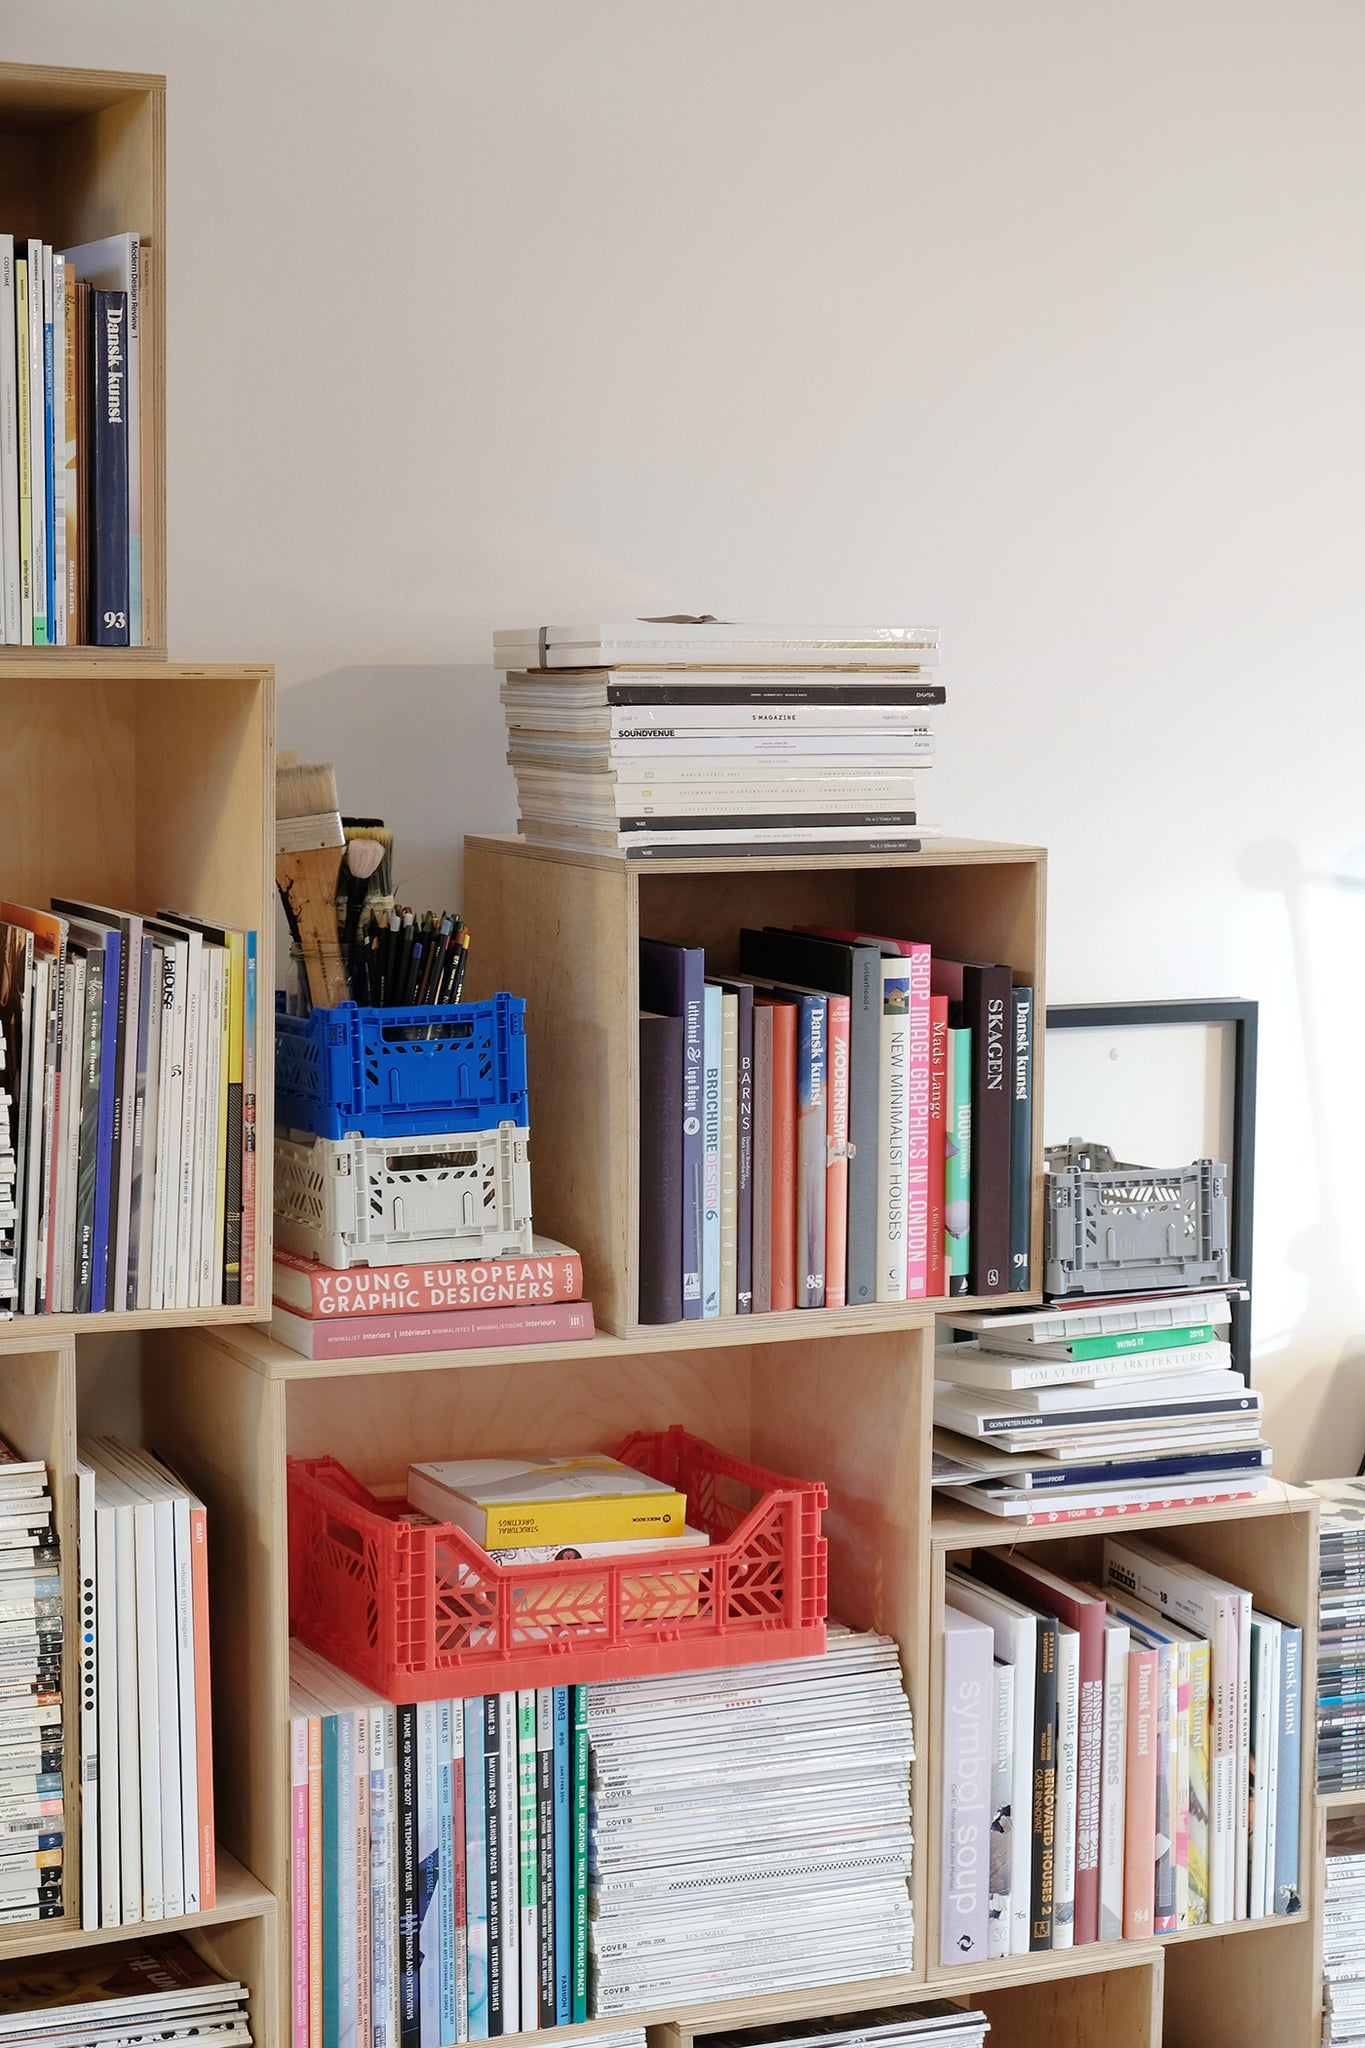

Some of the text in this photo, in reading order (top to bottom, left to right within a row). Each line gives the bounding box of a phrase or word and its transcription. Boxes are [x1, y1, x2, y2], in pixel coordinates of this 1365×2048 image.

[2, 256, 10, 288] COSTUME
[130, 273, 138, 301] Design
[106, 308, 124, 424] Dansk kunst
[103, 611, 126, 629] 93
[758, 714, 796, 722] MAGAZINE
[618, 729, 676, 737] SOUNDVENUE
[77, 965, 85, 992] VOGUE
[163, 956, 176, 1010] Jalouse
[863, 962, 871, 1005] Letterhead
[89, 1017, 99, 1083] view on flowers
[684, 1000, 702, 1112] Letterhead & Logo Design
[810, 1008, 825, 1107] Dansk kunst
[987, 998, 1003, 1090] SKAGEN
[1015, 1001, 1030, 1101] Dansk kunst
[930, 1021, 945, 1120] Mads Lange
[908, 952, 929, 1263] SHOP IMAGE GRAPHICS IN LONDON
[889, 1031, 904, 1241] NEW MINIMALIST HOUSES
[80, 1225, 90, 1285] Arts and Crafts
[1013, 1253, 1028, 1268] 91
[317, 1262, 554, 1295] YOUNG EUROPEAN
[806, 1273, 824, 1289] 85
[319, 1280, 554, 1314] GRAPHIC DESIGNERS
[362, 1319, 556, 1340] Interiors Intérieurs Interieurs
[1116, 1329, 1205, 1349] WING IT 2015
[1030, 1350, 1214, 1381] OM AT OPLEVE ARKITEKTUREN
[989, 1421, 1004, 1429] GLYN
[1021, 1418, 1043, 1426] MACHIN
[1067, 1509, 1087, 1518] TOUR
[180, 1562, 189, 1649] fashion magazine
[1193, 1656, 1206, 1703] Dansk
[1284, 1641, 1298, 1735] Dansk kunst
[487, 1700, 495, 1724] FRAME
[589, 1708, 617, 1717] COVER
[1137, 1663, 1152, 1756] Dansk kunst
[1163, 1681, 1172, 1723] Engineering
[1217, 1707, 1223, 1718] ON
[1229, 1704, 1235, 1716] ON
[1243, 1702, 1248, 1714] ON
[403, 1713, 412, 1739] FRAME
[442, 1732, 448, 1744] 35
[488, 1725, 495, 1735] 38
[542, 1718, 549, 1731] 33
[1062, 1664, 1077, 1791] minimalist garden
[1107, 1682, 1125, 1786] hot homes
[358, 1744, 365, 1754] 32
[374, 1745, 381, 1757] 28
[404, 1740, 412, 1754] #59
[578, 1733, 586, 1764] JUL/AUG
[404, 1756, 412, 1788] NOV/DEC
[488, 1757, 496, 1788] MAY/JUN
[1078, 1682, 1094, 1870] DANISH 250
[404, 1788, 412, 1806] 2007
[578, 1785, 586, 1808] MILAN
[605, 1789, 632, 1799] COVER
[948, 1682, 984, 1914] symbol soup
[1034, 1768, 1043, 1834] CASE RINNOVATE
[404, 1811, 412, 1826] THE
[489, 1815, 497, 1846] FASHION
[578, 1812, 586, 1853] EDUCATION
[606, 1818, 633, 1827] COVER
[1064, 1801, 1073, 1843] Christopher
[404, 1826, 413, 1871] TEMPORARY
[1041, 1768, 1055, 1916] RENOVATED HOUSES 2
[489, 1847, 497, 1875] SPACES
[405, 1871, 413, 1892] ISSUE
[426, 1873, 434, 1894] ISSUE
[490, 1880, 498, 1900] BARS
[606, 1882, 634, 1891] COVER
[405, 1897, 413, 1932] INTERIOR
[490, 1901, 498, 1916] AND
[405, 1932, 413, 1960] TRENDS
[577, 1942, 585, 1968] PUBLIC
[600, 1943, 628, 1953] COVER
[491, 1979, 499, 2012] FINISHES
[577, 1969, 585, 1997] SPACES
[603, 1986, 630, 1996] COVER
[406, 1977, 414, 2020] INTERVIEWS
